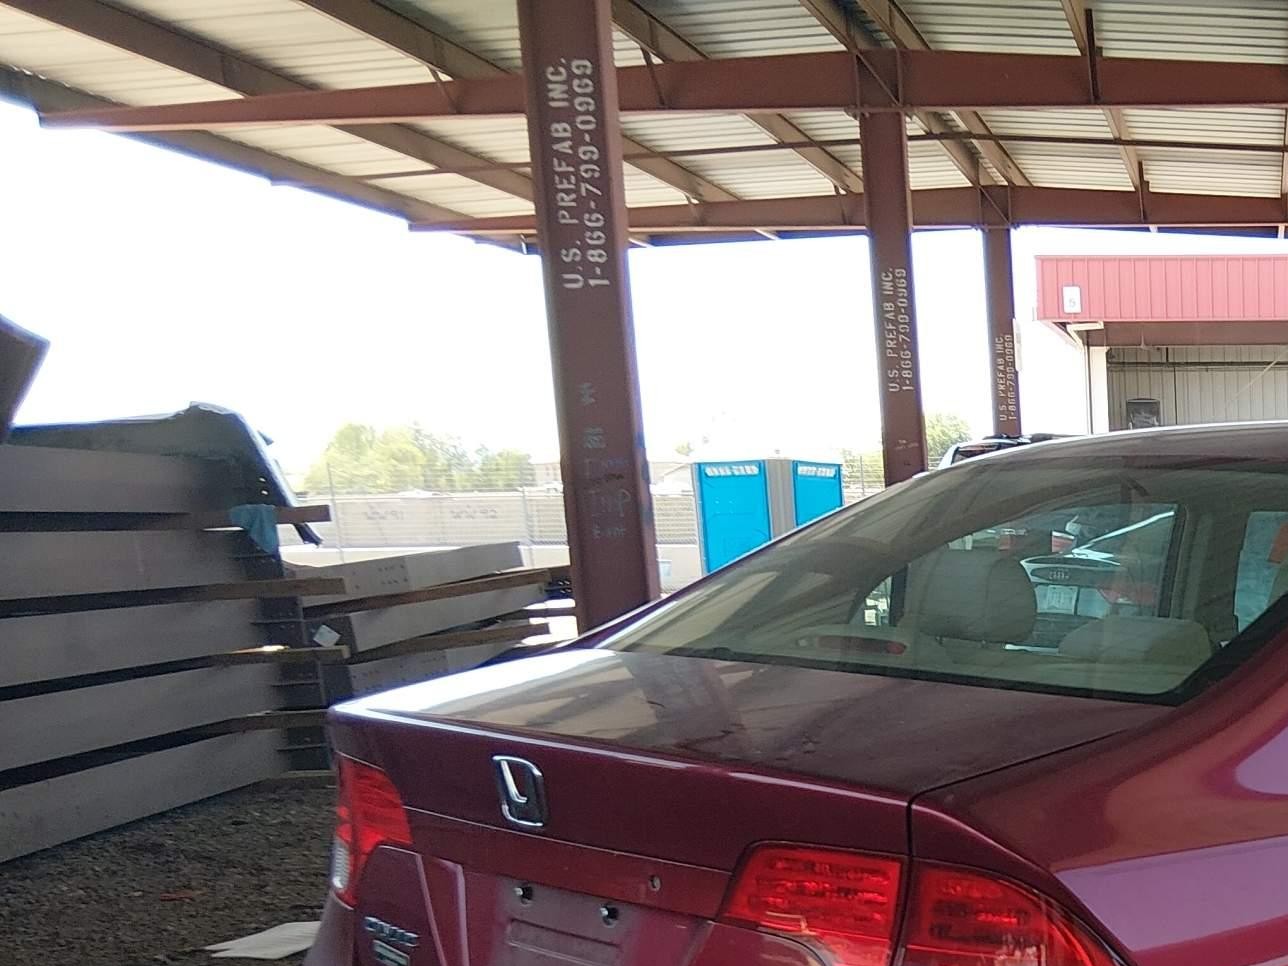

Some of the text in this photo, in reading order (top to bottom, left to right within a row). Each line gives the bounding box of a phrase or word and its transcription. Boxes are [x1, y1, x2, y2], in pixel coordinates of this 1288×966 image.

[546, 57, 586, 289] U.S. PREFAB INC.
[571, 58, 610, 288] 1-866-799-0969
[881, 267, 900, 392] U.S. PREFAB INC.
